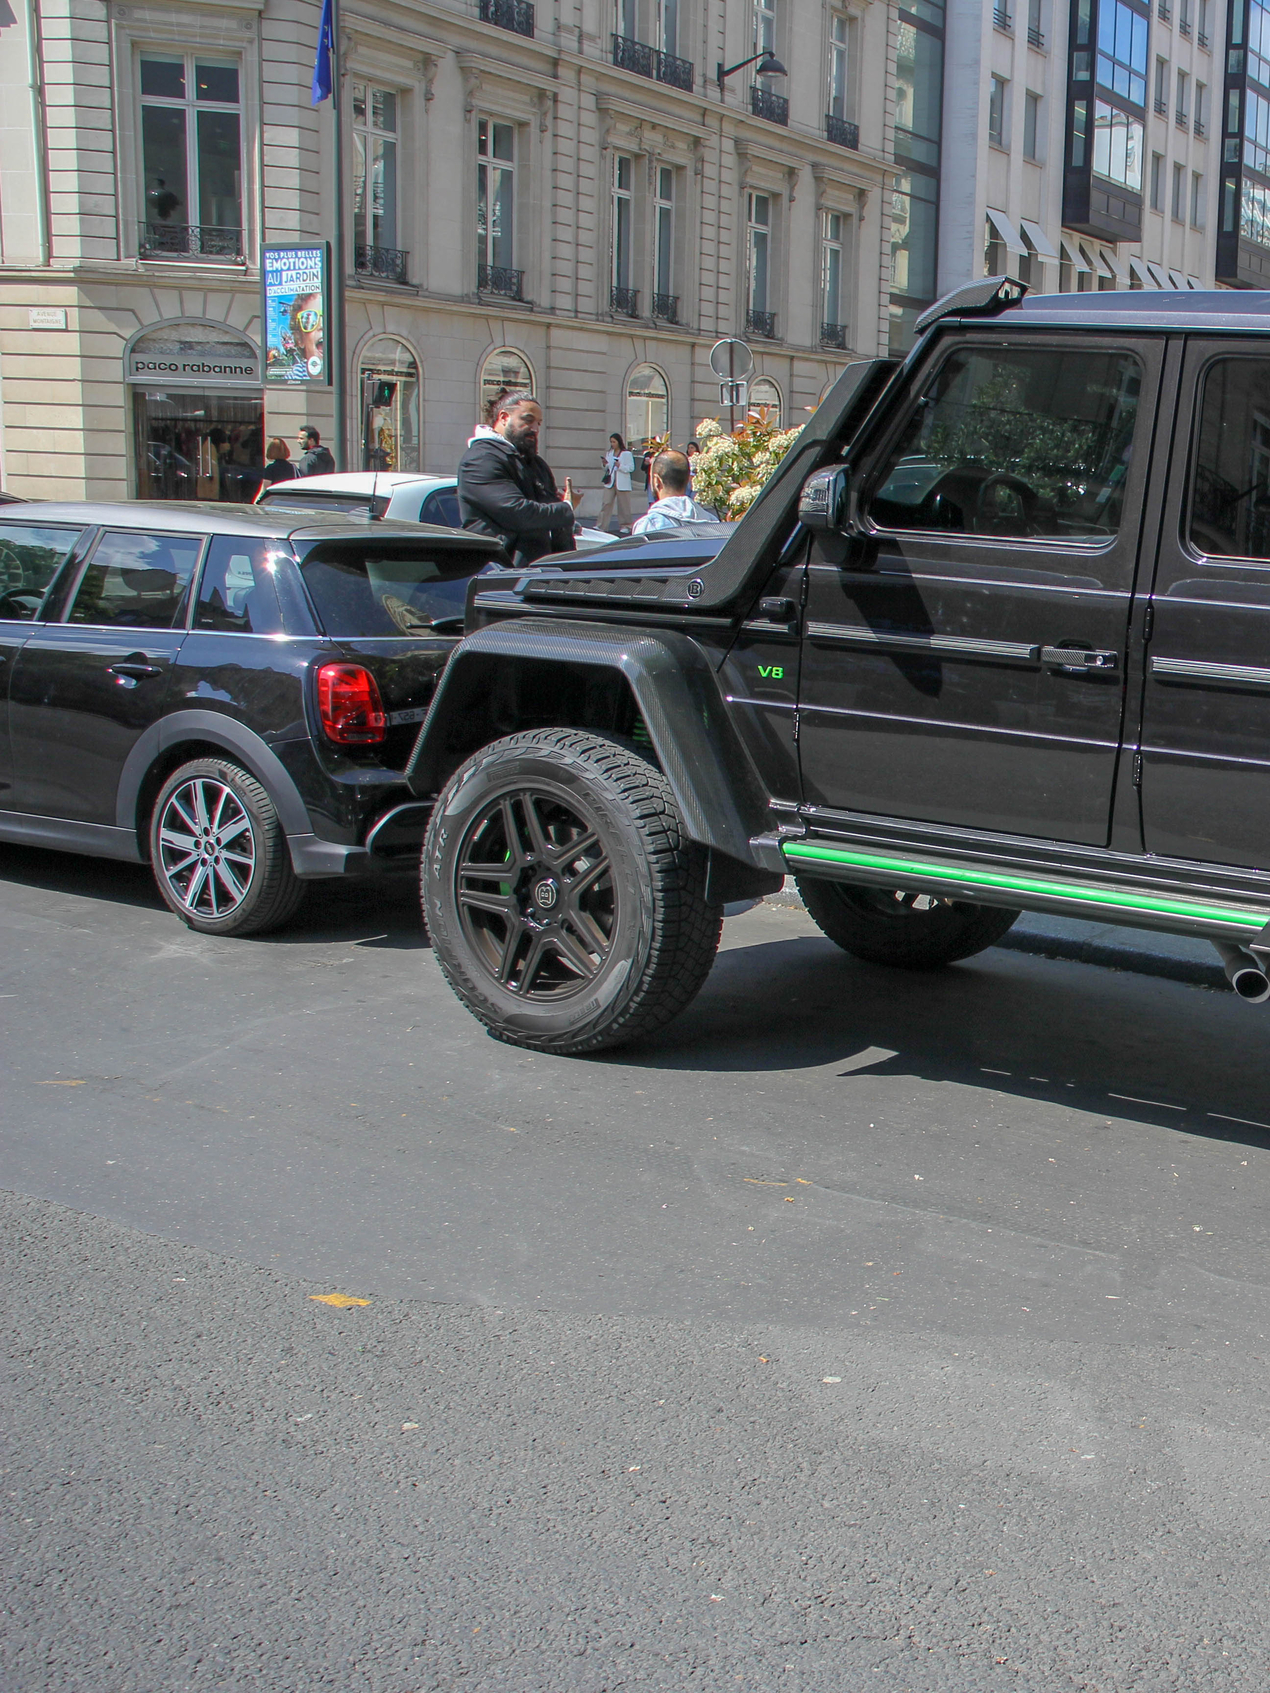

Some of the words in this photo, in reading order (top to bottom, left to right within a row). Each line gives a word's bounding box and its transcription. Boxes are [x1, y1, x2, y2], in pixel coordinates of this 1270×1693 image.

[298, 250, 321, 258] BELLES
[266, 257, 322, 271] EMOTIONS
[267, 272, 281, 285] AU
[284, 270, 320, 284] JARDIN
[135, 361, 179, 372] paco
[182, 362, 254, 375] rabanne
[757, 665, 784, 679] V8
[433, 828, 449, 880] ATR
